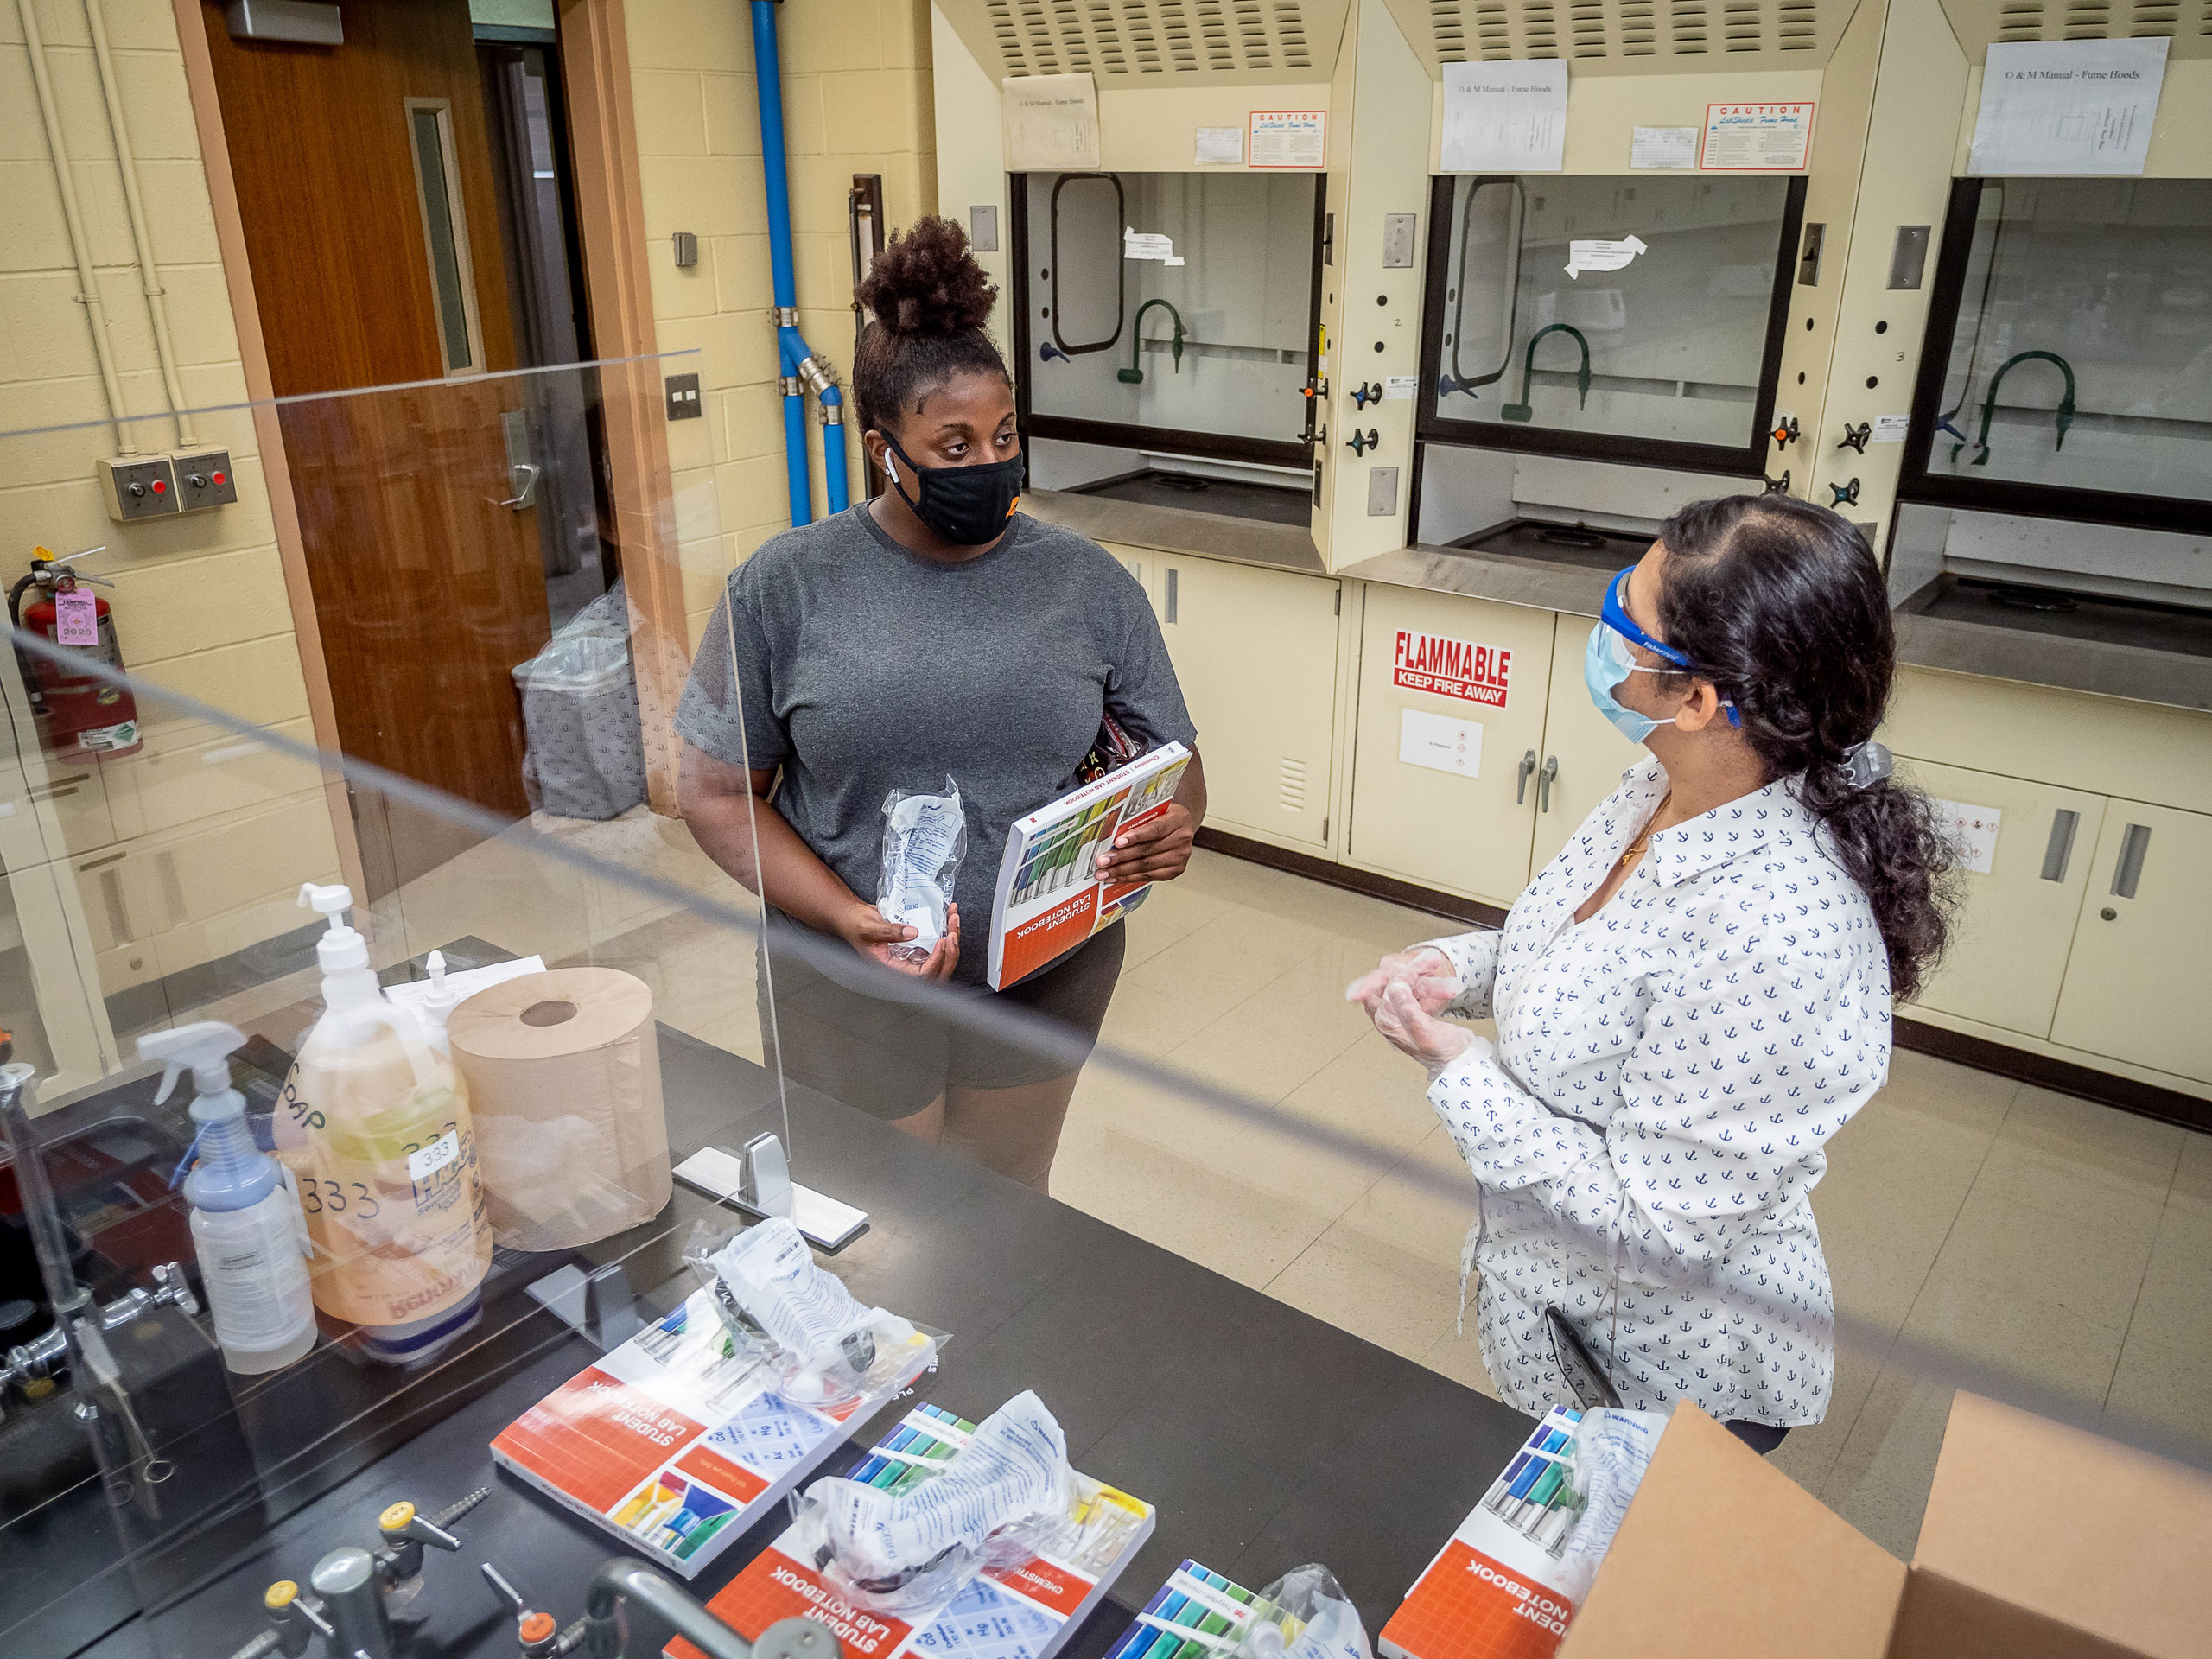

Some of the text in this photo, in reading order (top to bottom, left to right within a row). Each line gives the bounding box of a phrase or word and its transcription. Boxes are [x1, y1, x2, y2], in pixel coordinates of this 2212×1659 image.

[2005, 70, 2013, 79] O
[2016, 70, 2025, 79] &
[2026, 70, 2038, 79] M
[2038, 69, 2073, 79] Manual
[2082, 70, 2108, 79] Fume
[2109, 69, 2140, 79] Hoods
[1719, 106, 1801, 115] CAUTION
[1758, 116, 1777, 124] Fume
[1780, 115, 1799, 124] Hood
[1394, 318, 1402, 327] 2
[1896, 351, 1905, 362] 3
[1395, 631, 1510, 688] FLAMMABLE
[1398, 671, 1503, 703] KEEP FIRE AWAY
[1065, 754, 1160, 806] Chemistry STUDENT LAB NOTEBOOK
[904, 901, 919, 912] rand
[1016, 893, 1090, 939] LAB NOTEBOOK
[1046, 901, 1090, 931] STUDENT
[423, 1141, 450, 1166] 333
[302, 1178, 380, 1220] 333
[588, 1380, 688, 1437] LAB NOTEBOOK
[611, 1410, 675, 1446] STUDENT
[760, 1424, 772, 1436] Hg
[1611, 1414, 1649, 1435] WARNING
[769, 1565, 892, 1640] LAB NOTEBOOK
[1465, 1559, 1568, 1620] NOTEBOOK
[802, 1605, 879, 1654] STUDENT
[976, 1622, 989, 1637] Hg
[1513, 1602, 1567, 1638] DENT
[921, 1631, 937, 1646] Cd
